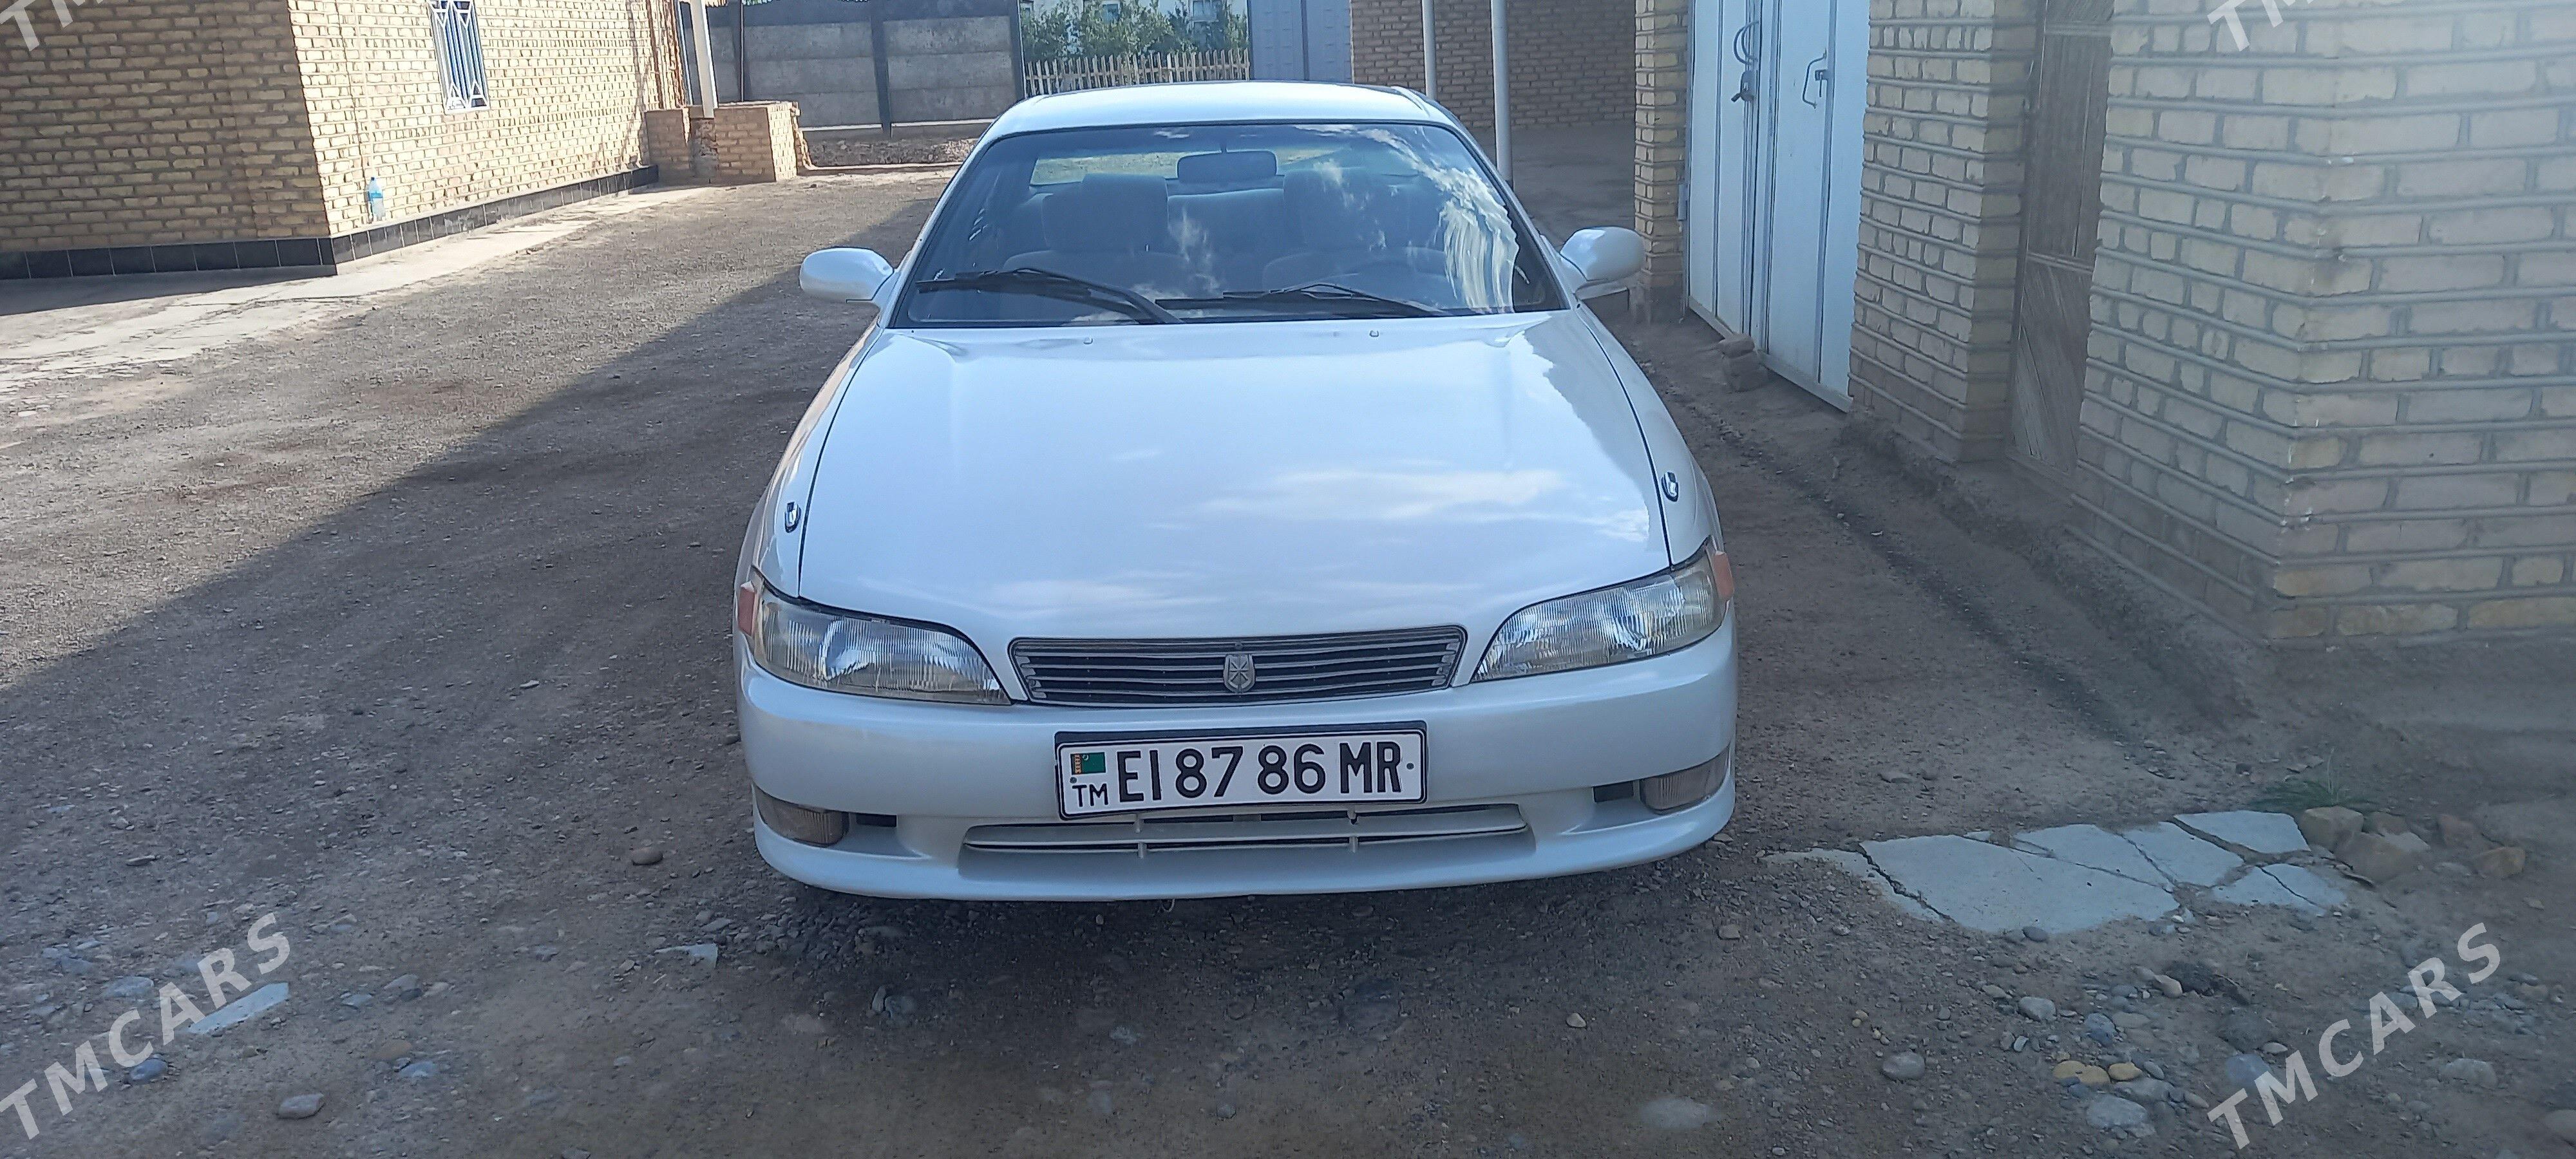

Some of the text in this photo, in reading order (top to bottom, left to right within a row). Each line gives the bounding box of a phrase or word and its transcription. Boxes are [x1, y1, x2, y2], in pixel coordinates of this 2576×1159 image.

[1175, 746, 1244, 798] 87
[1257, 744, 1325, 795] 86
[1340, 741, 1402, 793] MR
[1072, 783, 1109, 807] TM
